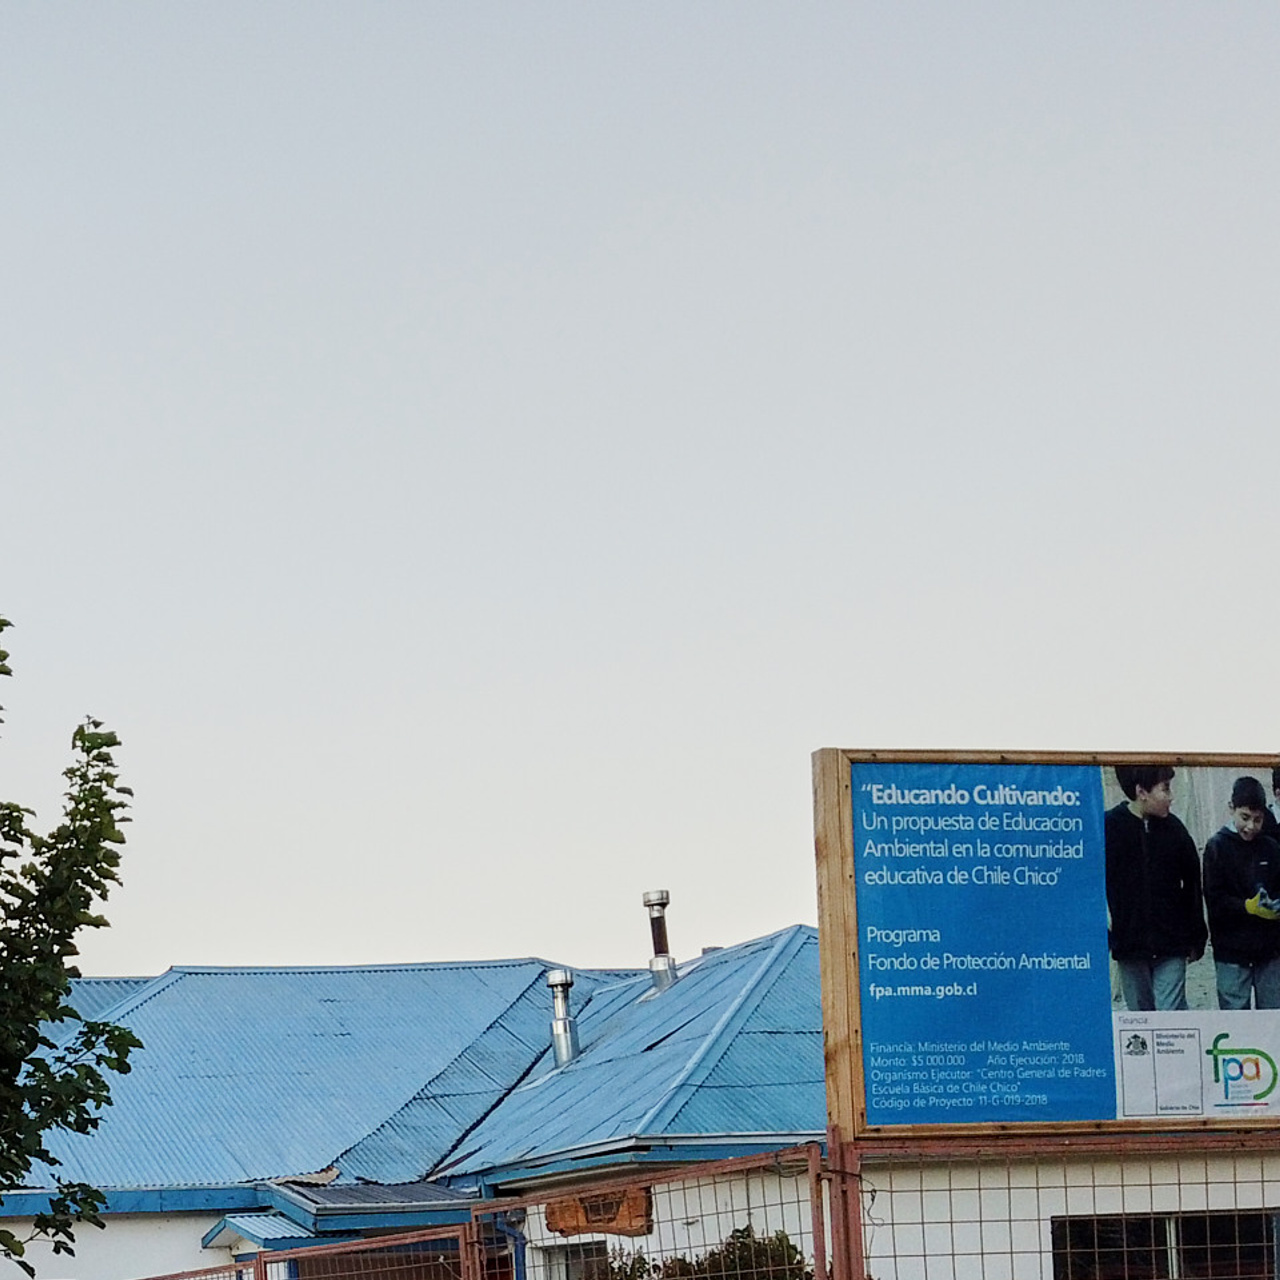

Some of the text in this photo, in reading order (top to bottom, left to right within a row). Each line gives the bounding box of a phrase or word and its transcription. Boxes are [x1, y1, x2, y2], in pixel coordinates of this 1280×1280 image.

[973, 785, 1080, 806] Cultivando:
[862, 812, 888, 830] Un
[892, 814, 974, 834] propuesta
[978, 812, 999, 831] de
[863, 839, 1083, 858] Ambiental en la comunidad
[865, 866, 943, 885] educativa
[947, 866, 968, 884] de
[972, 866, 1010, 885] Chile
[867, 926, 940, 947] Programa
[869, 952, 1090, 970] Fondo de Protección Ambiental
[869, 983, 977, 999] fpa.mma.gob.cl
[918, 1041, 967, 1053] Ministerio
[970, 1040, 985, 1052] del
[988, 1041, 1019, 1052] Medio
[1022, 1040, 1070, 1051] Ambiente
[987, 1055, 1007, 1065] Año
[1062, 1053, 1085, 1064] 2018
[1017, 1067, 1056, 1079] General
[1058, 1067, 1071, 1078] de
[1074, 1067, 1107, 1078] Padres
[871, 1083, 910, 1095] Escuela
[913, 1082, 944, 1094] Básica
[946, 1082, 960, 1093] de
[962, 1081, 987, 1093] Chile
[872, 1097, 910, 1110] Código
[913, 1097, 927, 1108] de
